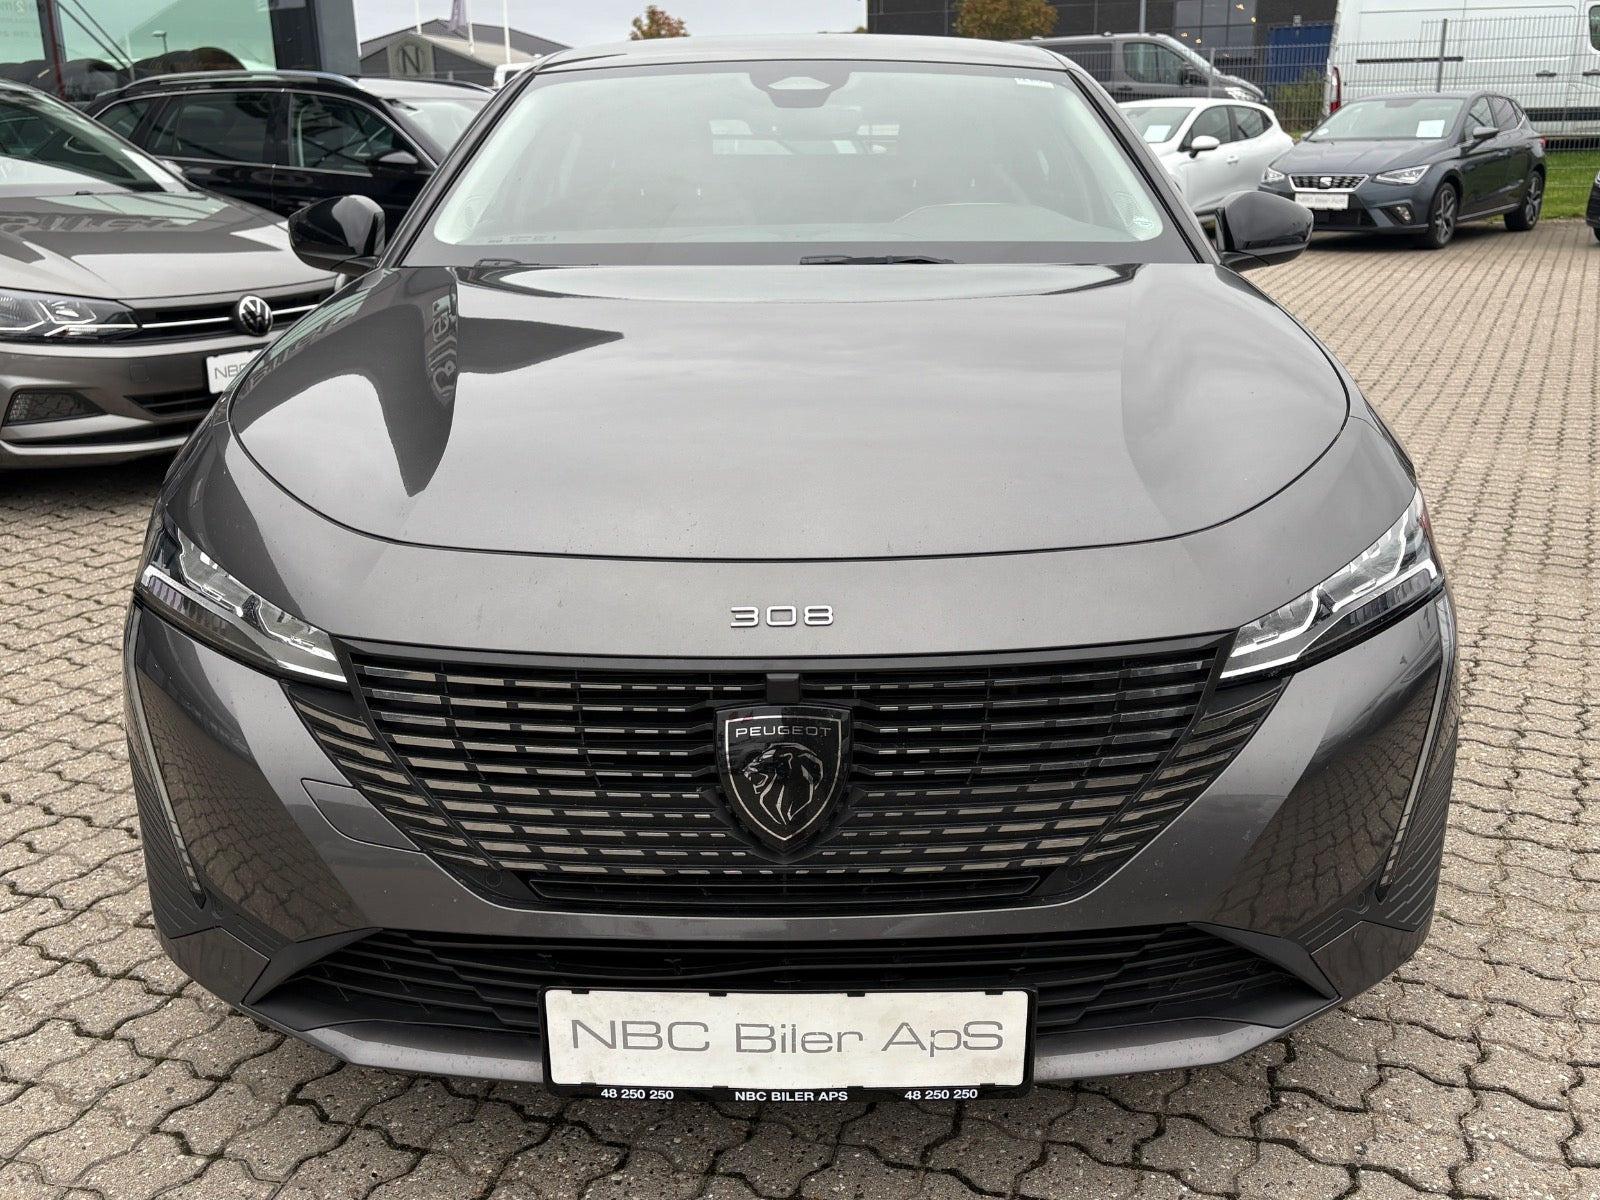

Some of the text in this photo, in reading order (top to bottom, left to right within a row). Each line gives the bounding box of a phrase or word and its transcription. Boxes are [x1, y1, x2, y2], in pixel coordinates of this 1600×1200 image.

[401, 47, 421, 75] N
[730, 605, 833, 628] 308
[735, 725, 832, 738] PEUGEOT
[571, 1019, 1004, 1057] NBC Biler ApS
[601, 1088, 675, 1100] 48 250 250
[735, 1091, 848, 1102] NBC BILER APS
[904, 1088, 978, 1100] 48 250 250
